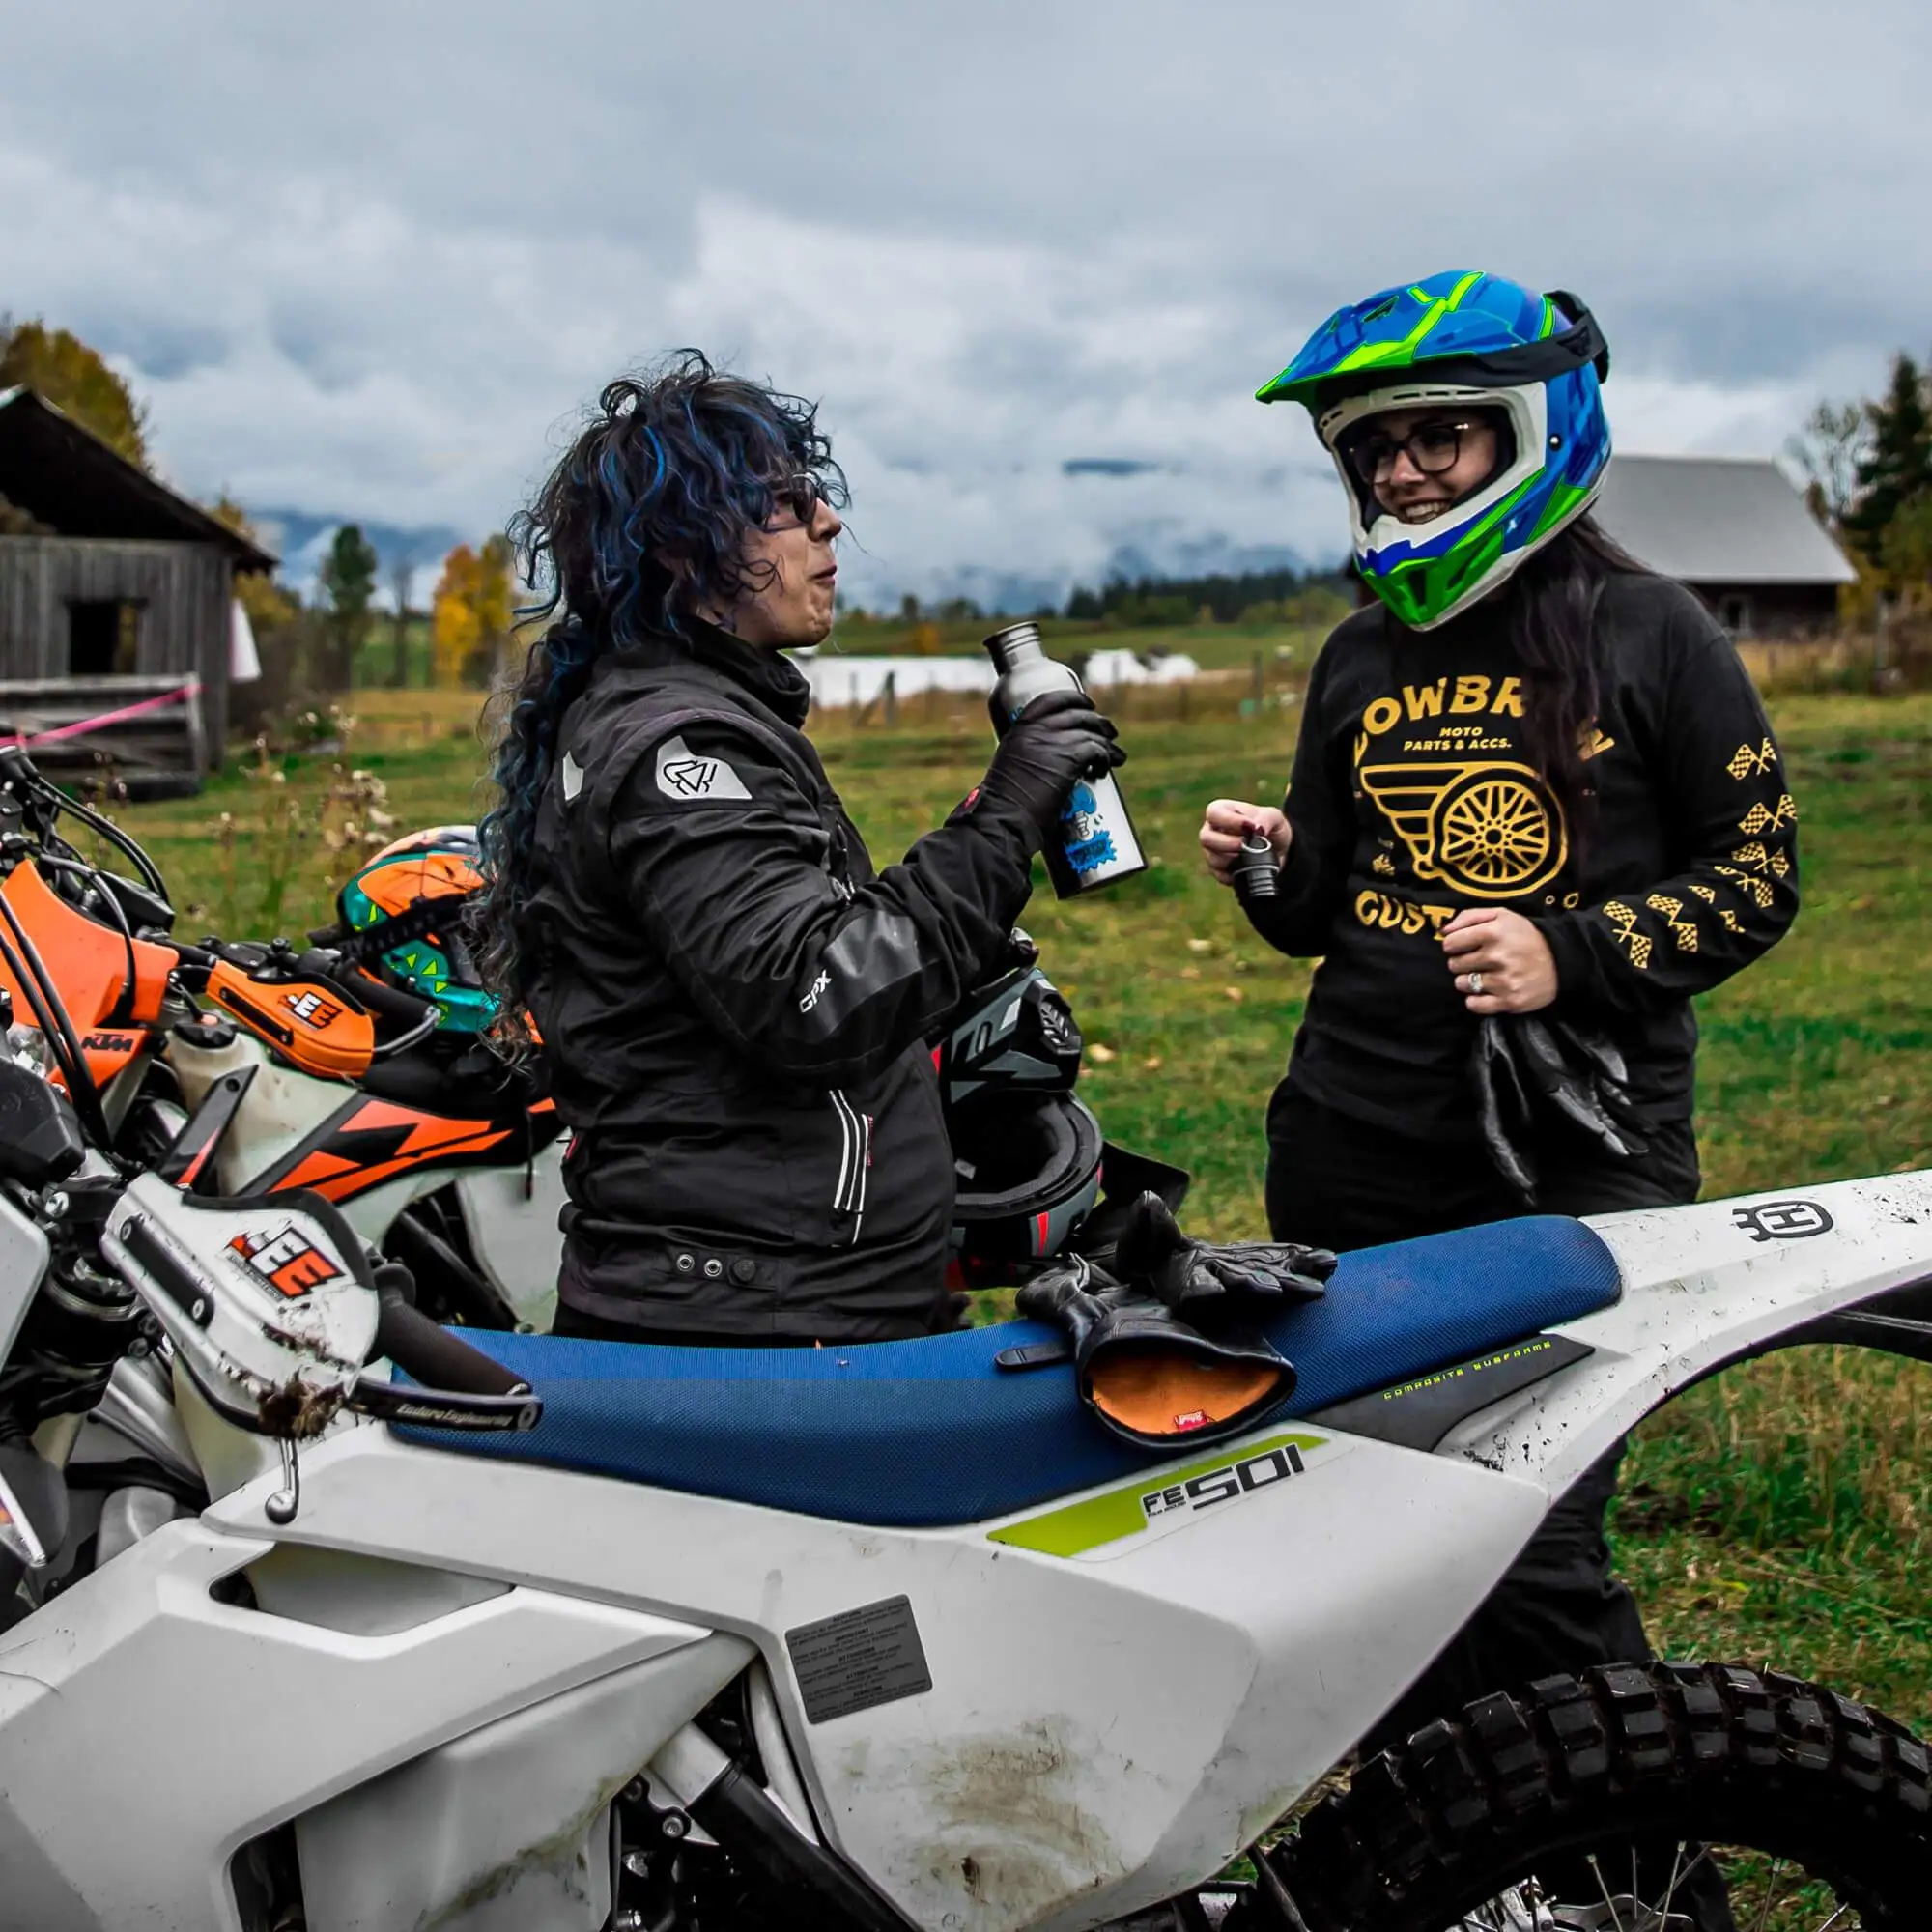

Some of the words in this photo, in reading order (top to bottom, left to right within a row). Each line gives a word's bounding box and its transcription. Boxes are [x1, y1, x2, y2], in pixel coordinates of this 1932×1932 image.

[1439, 725, 1483, 738] MOTO
[1403, 740, 1451, 752] PARTS
[1467, 738, 1512, 750] ACCS.
[1354, 889, 1455, 942] CUST
[81, 1033, 133, 1052] KTM
[1383, 1367, 1464, 1401] COMPOSITE
[1472, 1340, 1552, 1372] SUBFRAME
